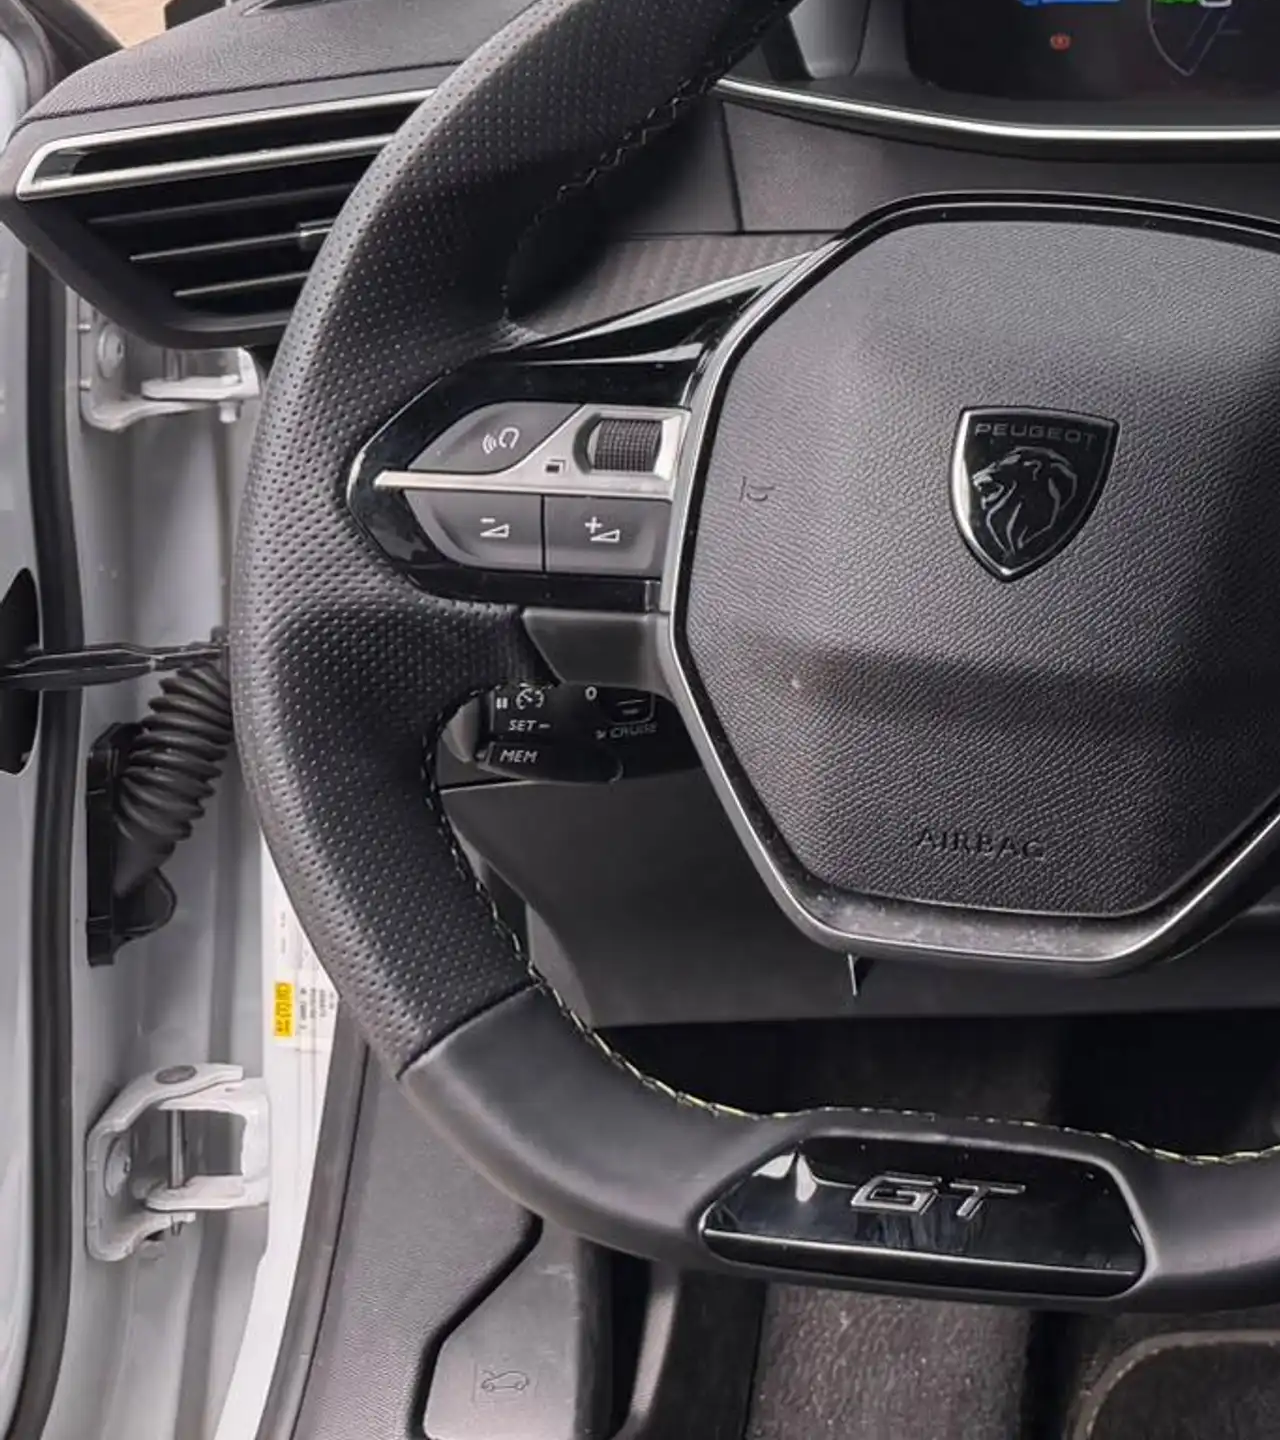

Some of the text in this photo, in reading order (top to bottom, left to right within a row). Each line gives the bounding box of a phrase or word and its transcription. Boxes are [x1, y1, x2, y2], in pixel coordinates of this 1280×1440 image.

[974, 422, 1097, 449] PEUGEOT
[508, 719, 537, 731] SET
[499, 750, 538, 763] MEM
[850, 1171, 1026, 1221] GT
